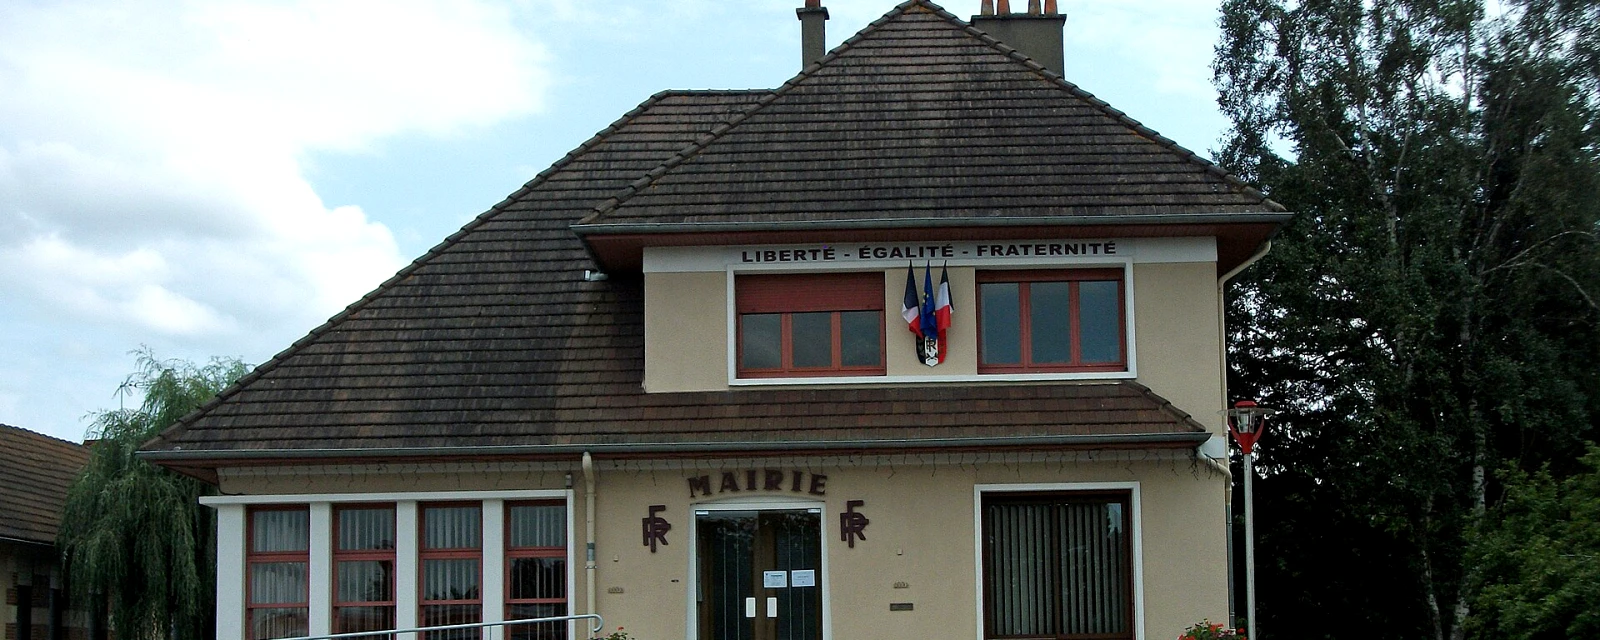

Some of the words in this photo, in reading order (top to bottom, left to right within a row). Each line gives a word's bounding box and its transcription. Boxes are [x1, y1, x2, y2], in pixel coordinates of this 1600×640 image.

[742, 247, 836, 263] LIBERTÉ
[859, 244, 954, 260] ÉGALITÉ
[977, 241, 1117, 257] FRATERNITÉ
[687, 470, 828, 498] MAIRIE
